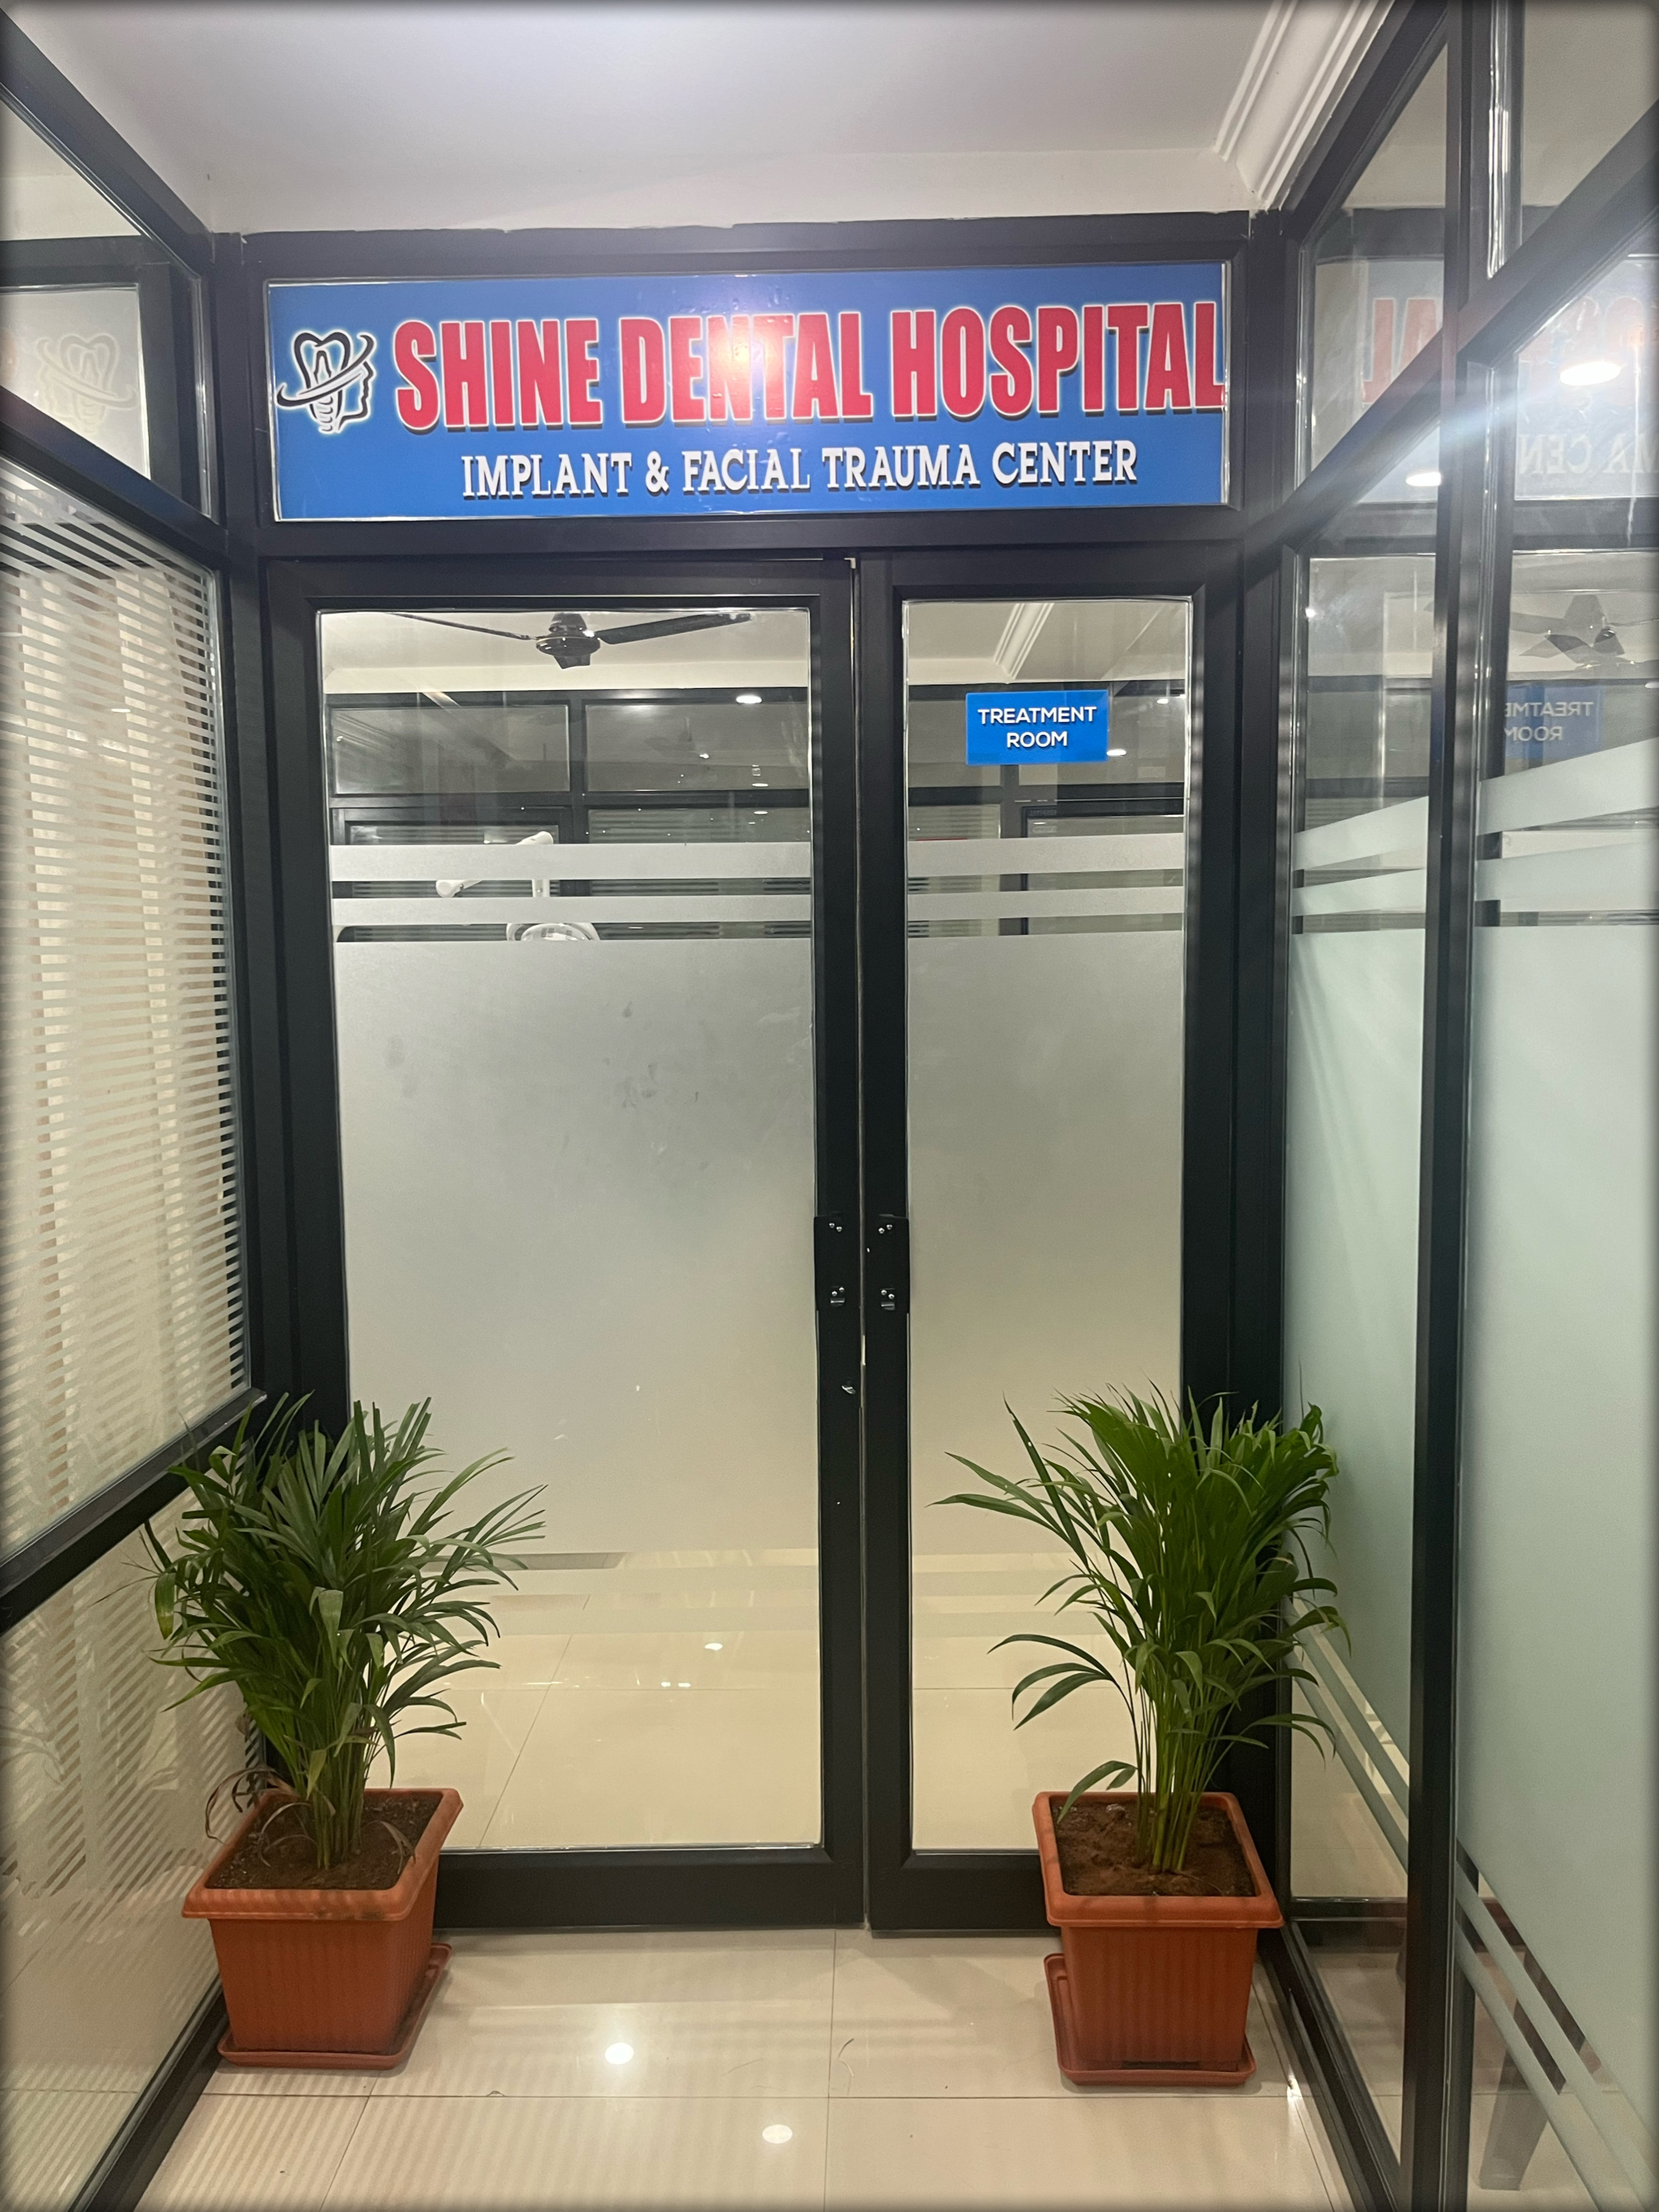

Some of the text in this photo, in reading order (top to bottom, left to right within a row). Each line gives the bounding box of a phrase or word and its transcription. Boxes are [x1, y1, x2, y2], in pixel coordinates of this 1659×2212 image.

[393, 318, 603, 431] SHINE
[618, 311, 873, 427] DENTAL
[890, 301, 1225, 418] HOSPITAL
[461, 440, 1138, 498] IMPLANT & FACIAL TRAUMA CENTER
[977, 706, 1097, 725] TREATMENT
[1006, 731, 1068, 748] ROOM
